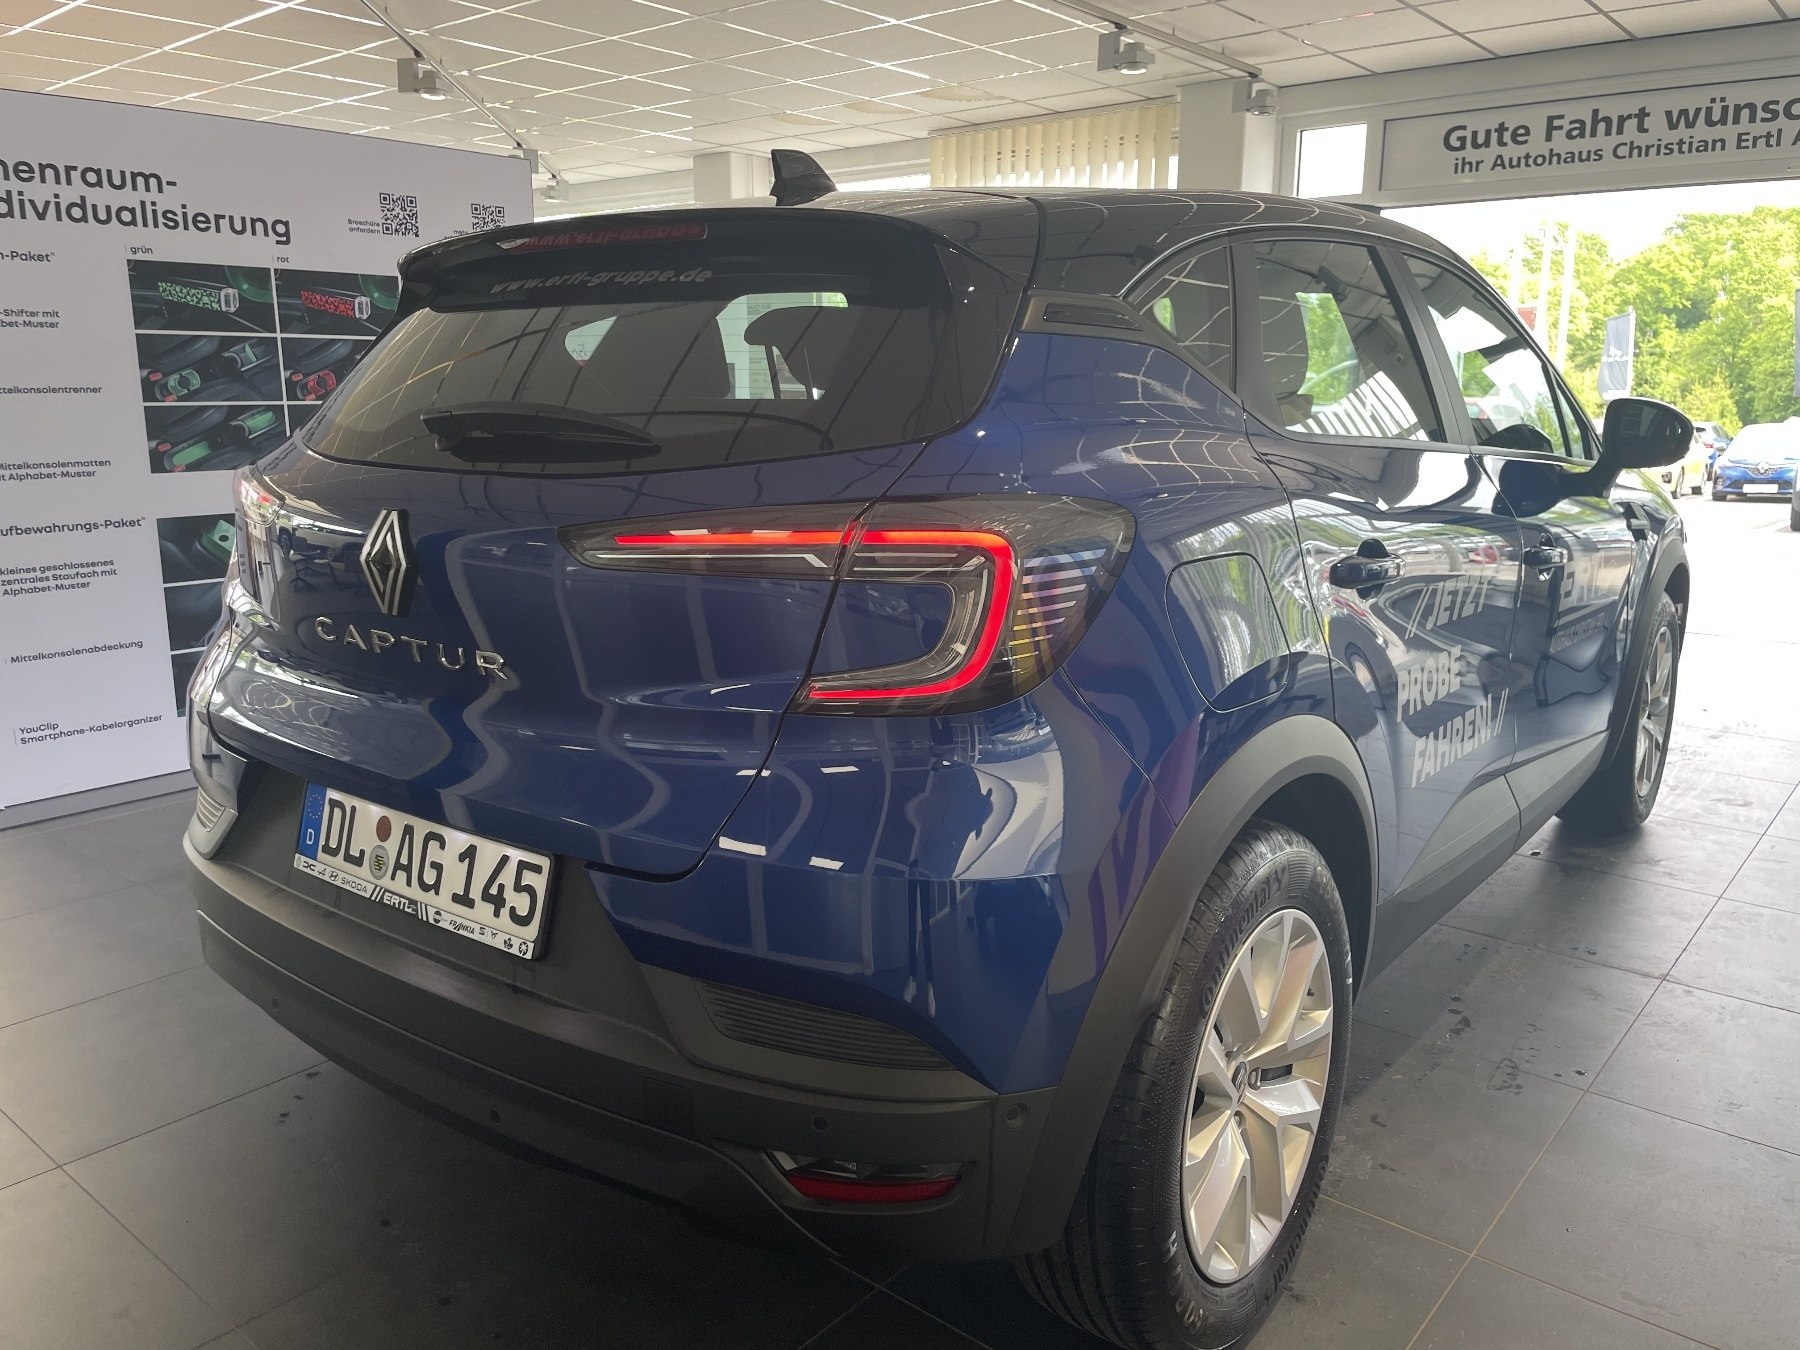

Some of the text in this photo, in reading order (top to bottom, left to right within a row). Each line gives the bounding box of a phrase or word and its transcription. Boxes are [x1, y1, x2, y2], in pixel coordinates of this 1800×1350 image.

[1443, 97, 1800, 152] Gute Fahrt wünsc
[1453, 157, 1484, 174] ihr
[1490, 147, 1604, 171] Autohaus
[1612, 135, 1727, 160] Christian
[1736, 128, 1782, 150] Ertl
[0, 190, 291, 245] dividualisierung
[347, 218, 381, 228] Broschüre
[348, 226, 381, 235] anfordern
[130, 246, 154, 255] grün
[276, 256, 290, 264] rot
[490, 268, 712, 293] www.ertl-gruppe.de
[42, 309, 60, 318] mit
[0, 319, 60, 329] bet-Muster
[8, 469, 97, 482] Alphabet-Muster
[0, 559, 115, 576] kleines geschlossenes
[1, 567, 118, 587] zentrales Staufach mit
[2, 581, 91, 597] Alphabet-Muster
[1426, 572, 1492, 631] JETZT
[10, 640, 144, 664] Mittelkonsolenabdeckung
[314, 616, 508, 680] CAPTUR
[1396, 644, 1462, 723] PROBE
[19, 722, 59, 735] YouClip
[20, 714, 163, 745] Smartphone-Kabelorganizer
[1411, 693, 1492, 789] FAHREN!
[306, 828, 315, 845] D
[321, 797, 543, 927] DL AG 145
[448, 919, 475, 935] FRANKIA
